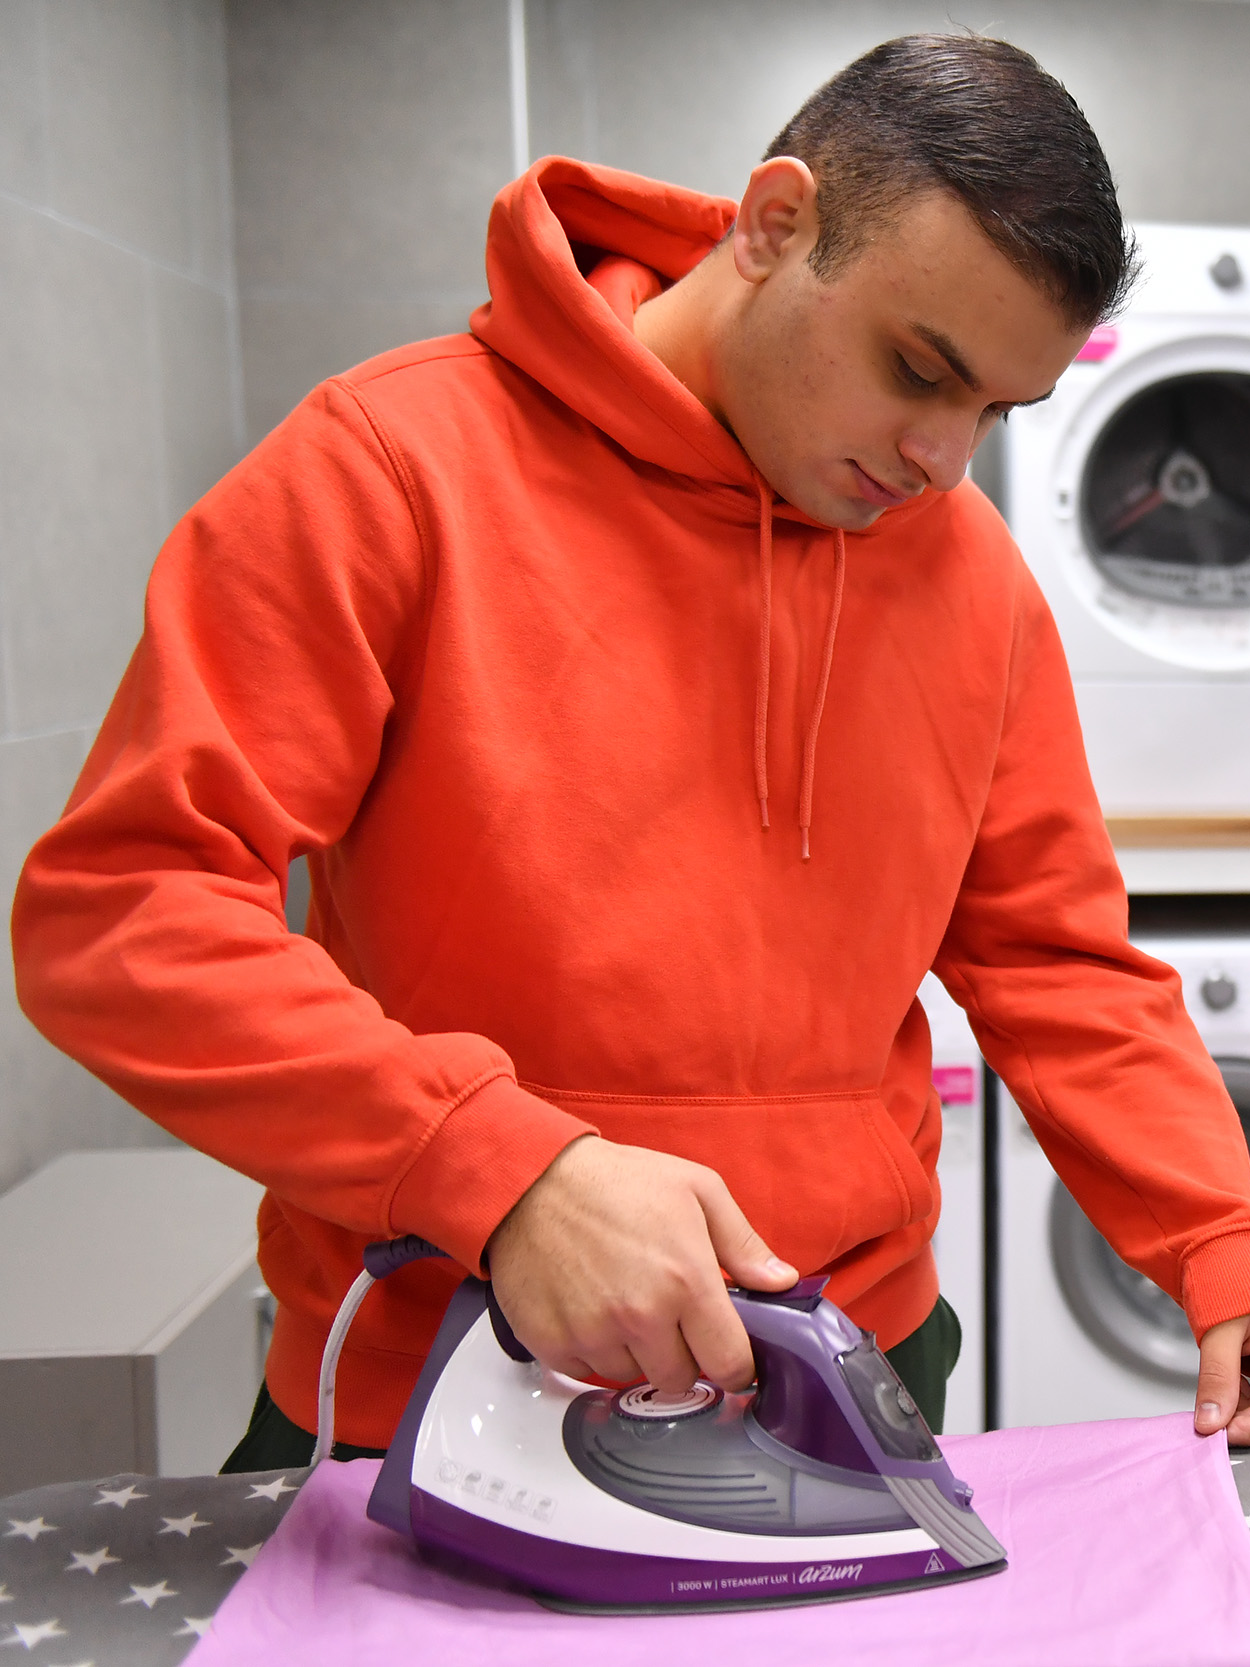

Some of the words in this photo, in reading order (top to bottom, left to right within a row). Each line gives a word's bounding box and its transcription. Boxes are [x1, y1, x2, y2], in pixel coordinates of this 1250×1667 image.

[677, 1581, 702, 1591] 3000
[703, 1581, 713, 1590] W
[721, 1575, 768, 1589] STEAMART
[770, 1574, 788, 1585] LUX
[799, 1563, 863, 1584] arzum
